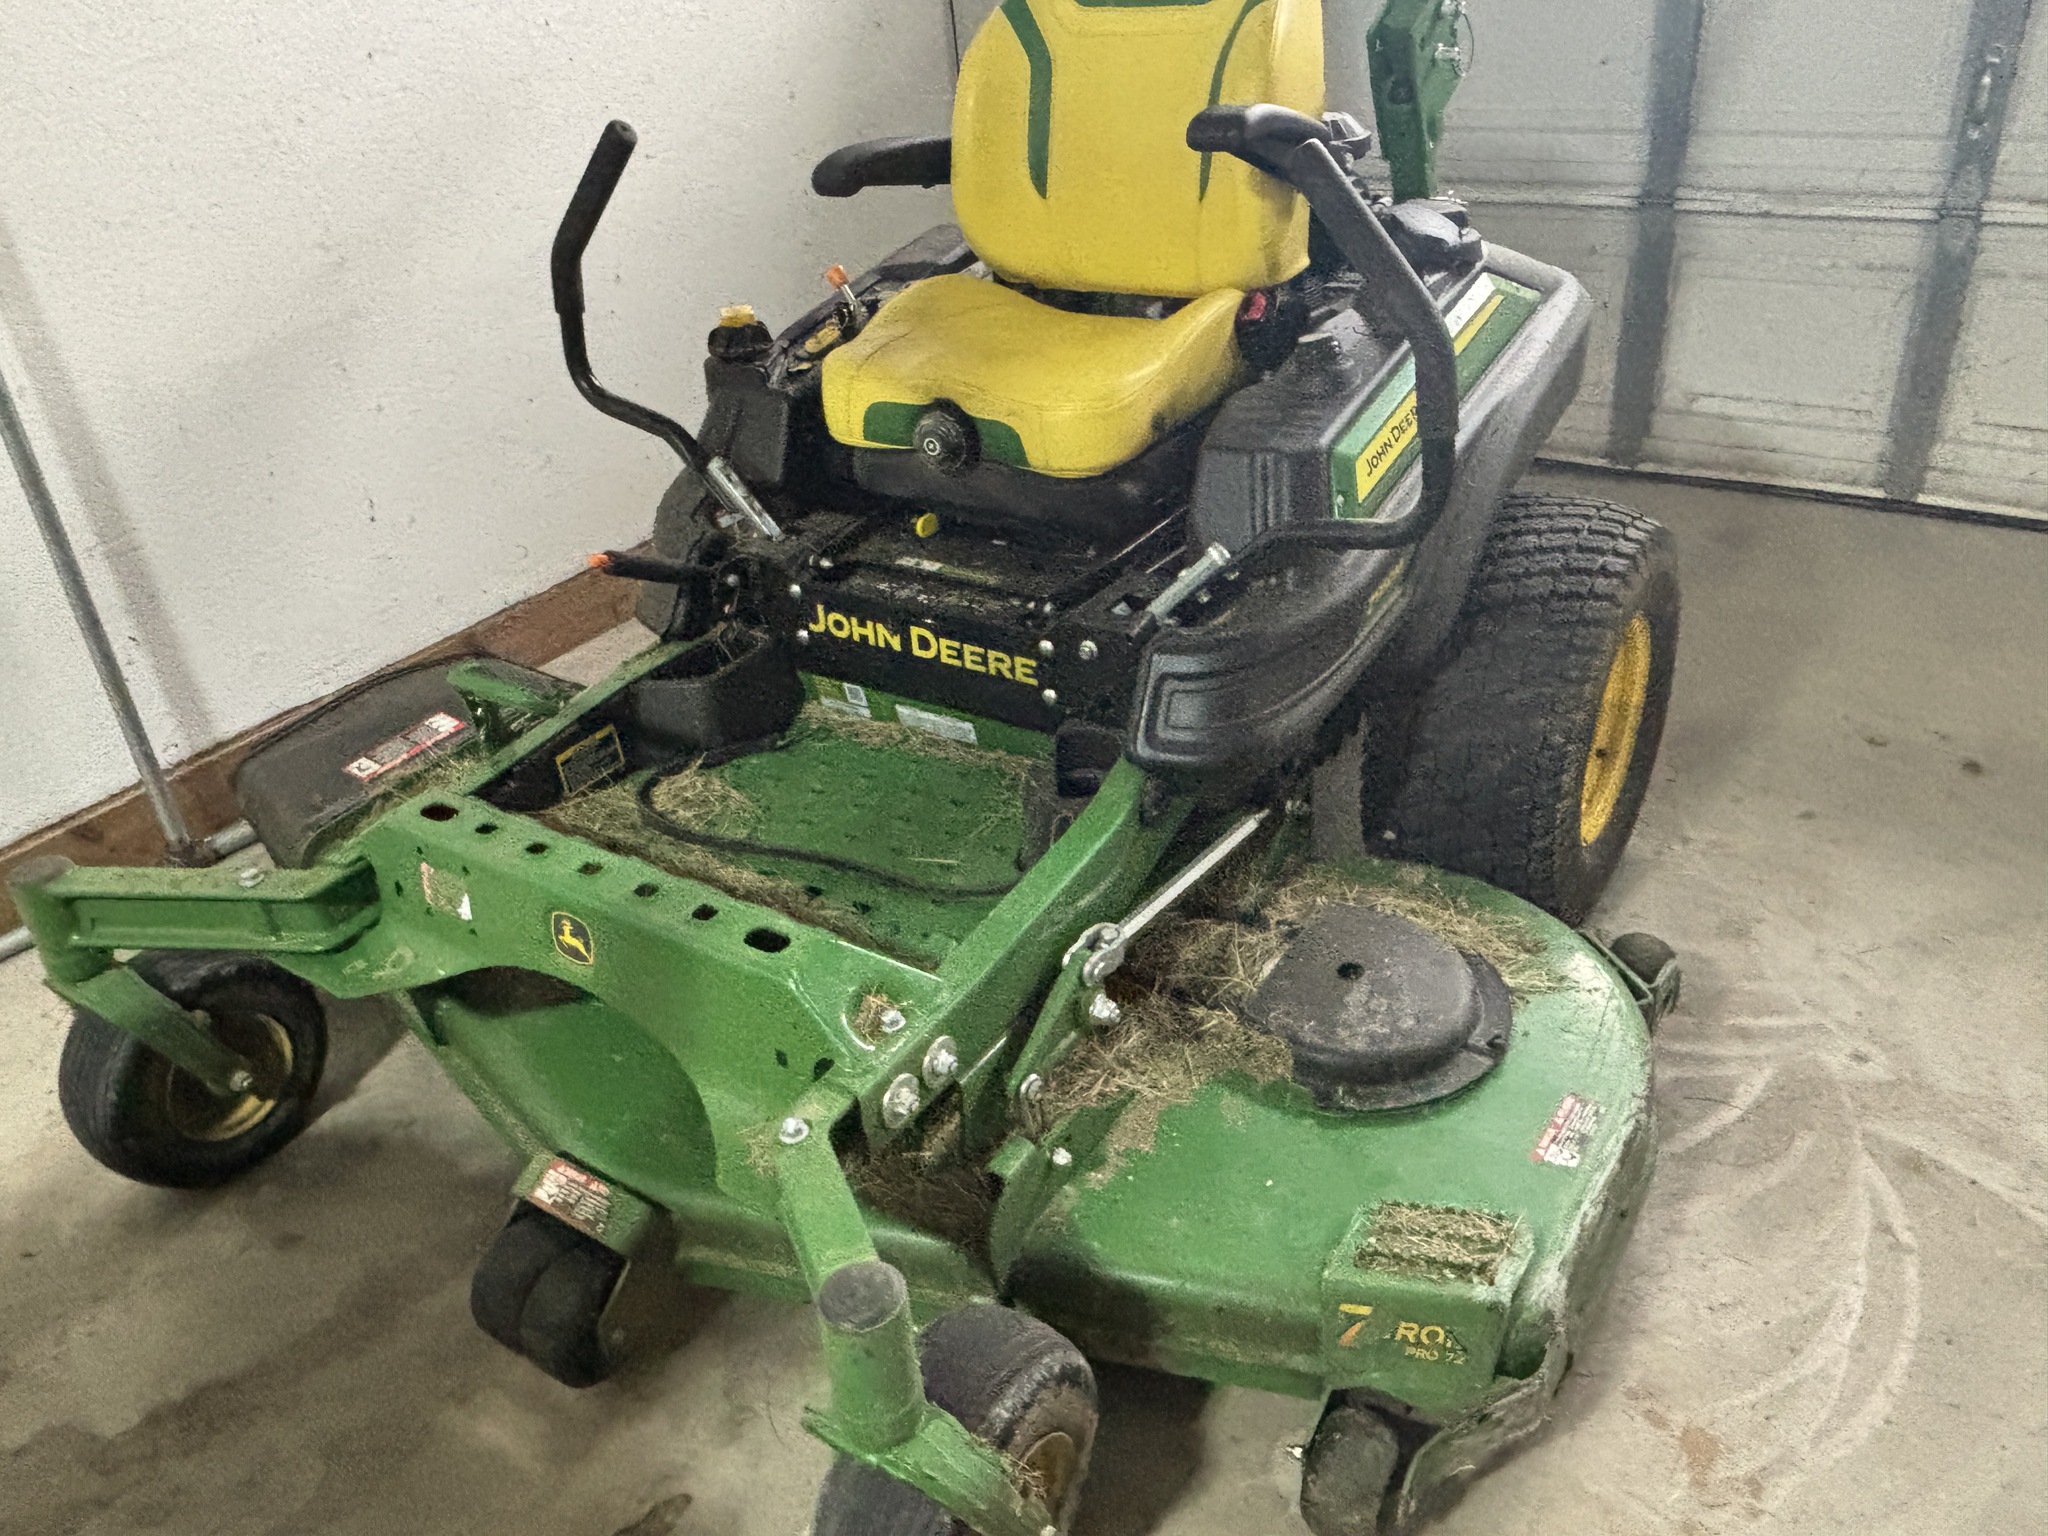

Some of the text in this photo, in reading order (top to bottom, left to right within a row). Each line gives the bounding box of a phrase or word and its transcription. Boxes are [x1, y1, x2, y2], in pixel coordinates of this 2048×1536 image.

[1366, 405, 1418, 477] JOHN DEER
[808, 603, 1039, 687] JOHN DEERE
